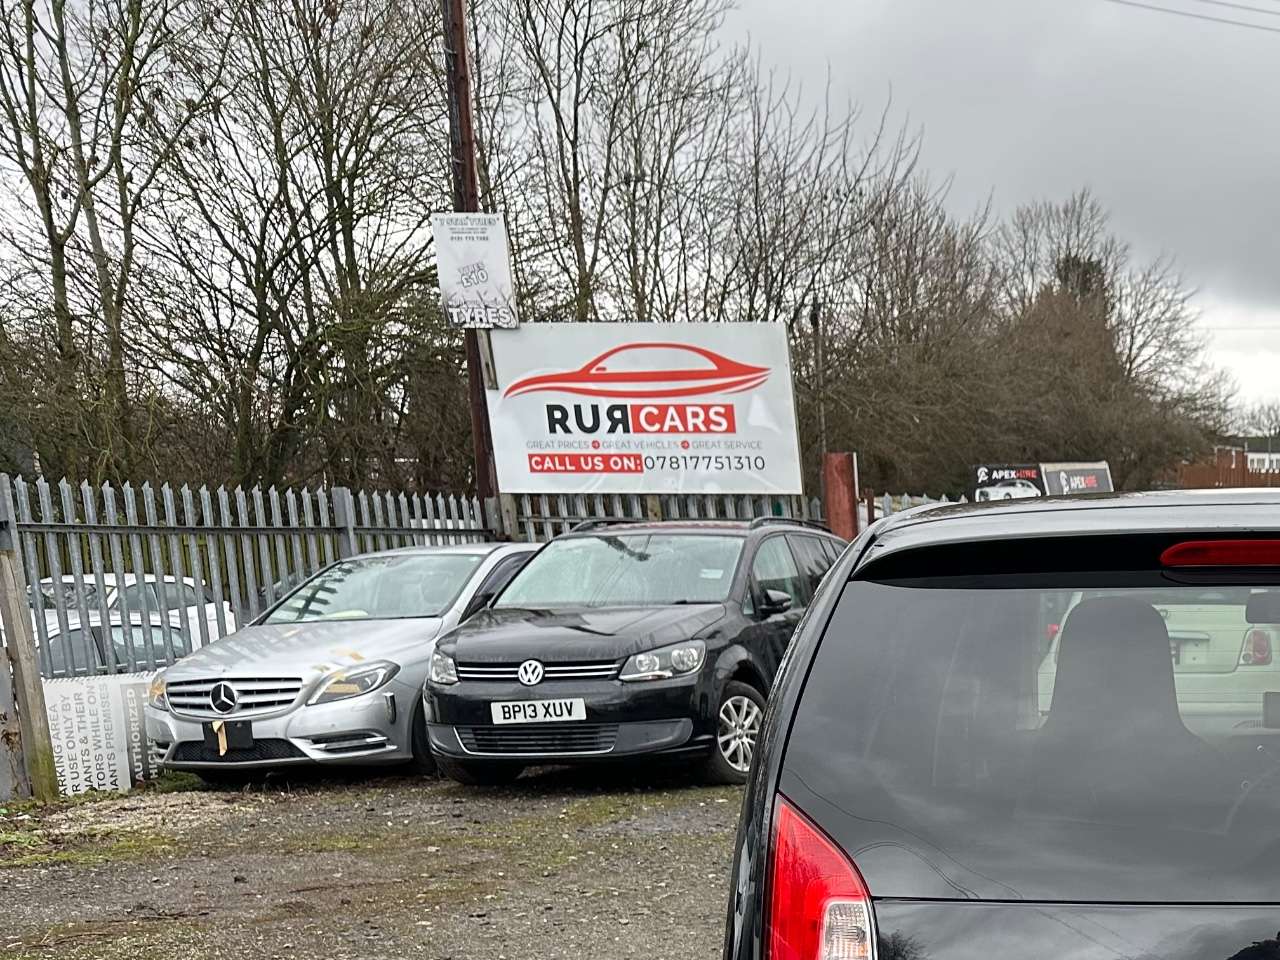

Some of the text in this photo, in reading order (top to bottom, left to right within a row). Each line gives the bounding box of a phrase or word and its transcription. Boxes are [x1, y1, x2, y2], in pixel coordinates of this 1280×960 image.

[461, 268, 489, 288] £10
[448, 307, 512, 325] TYRES
[526, 440, 764, 450] GREAT PRICES GREAT VEHICLES GREAT SERVICE
[531, 455, 766, 471] CALL US ON: 07817751310
[60, 695, 71, 712] BY
[74, 692, 86, 732] THEIR
[99, 683, 115, 749] PREMISES
[501, 702, 573, 720] BP13 XUV
[63, 715, 76, 749] ONLY
[80, 736, 88, 745] &
[87, 683, 106, 789] TORS WHILE ON
[127, 688, 144, 779] AUTHORIZED
[49, 704, 69, 798] ARKING AREA
[68, 753, 80, 784] USE
